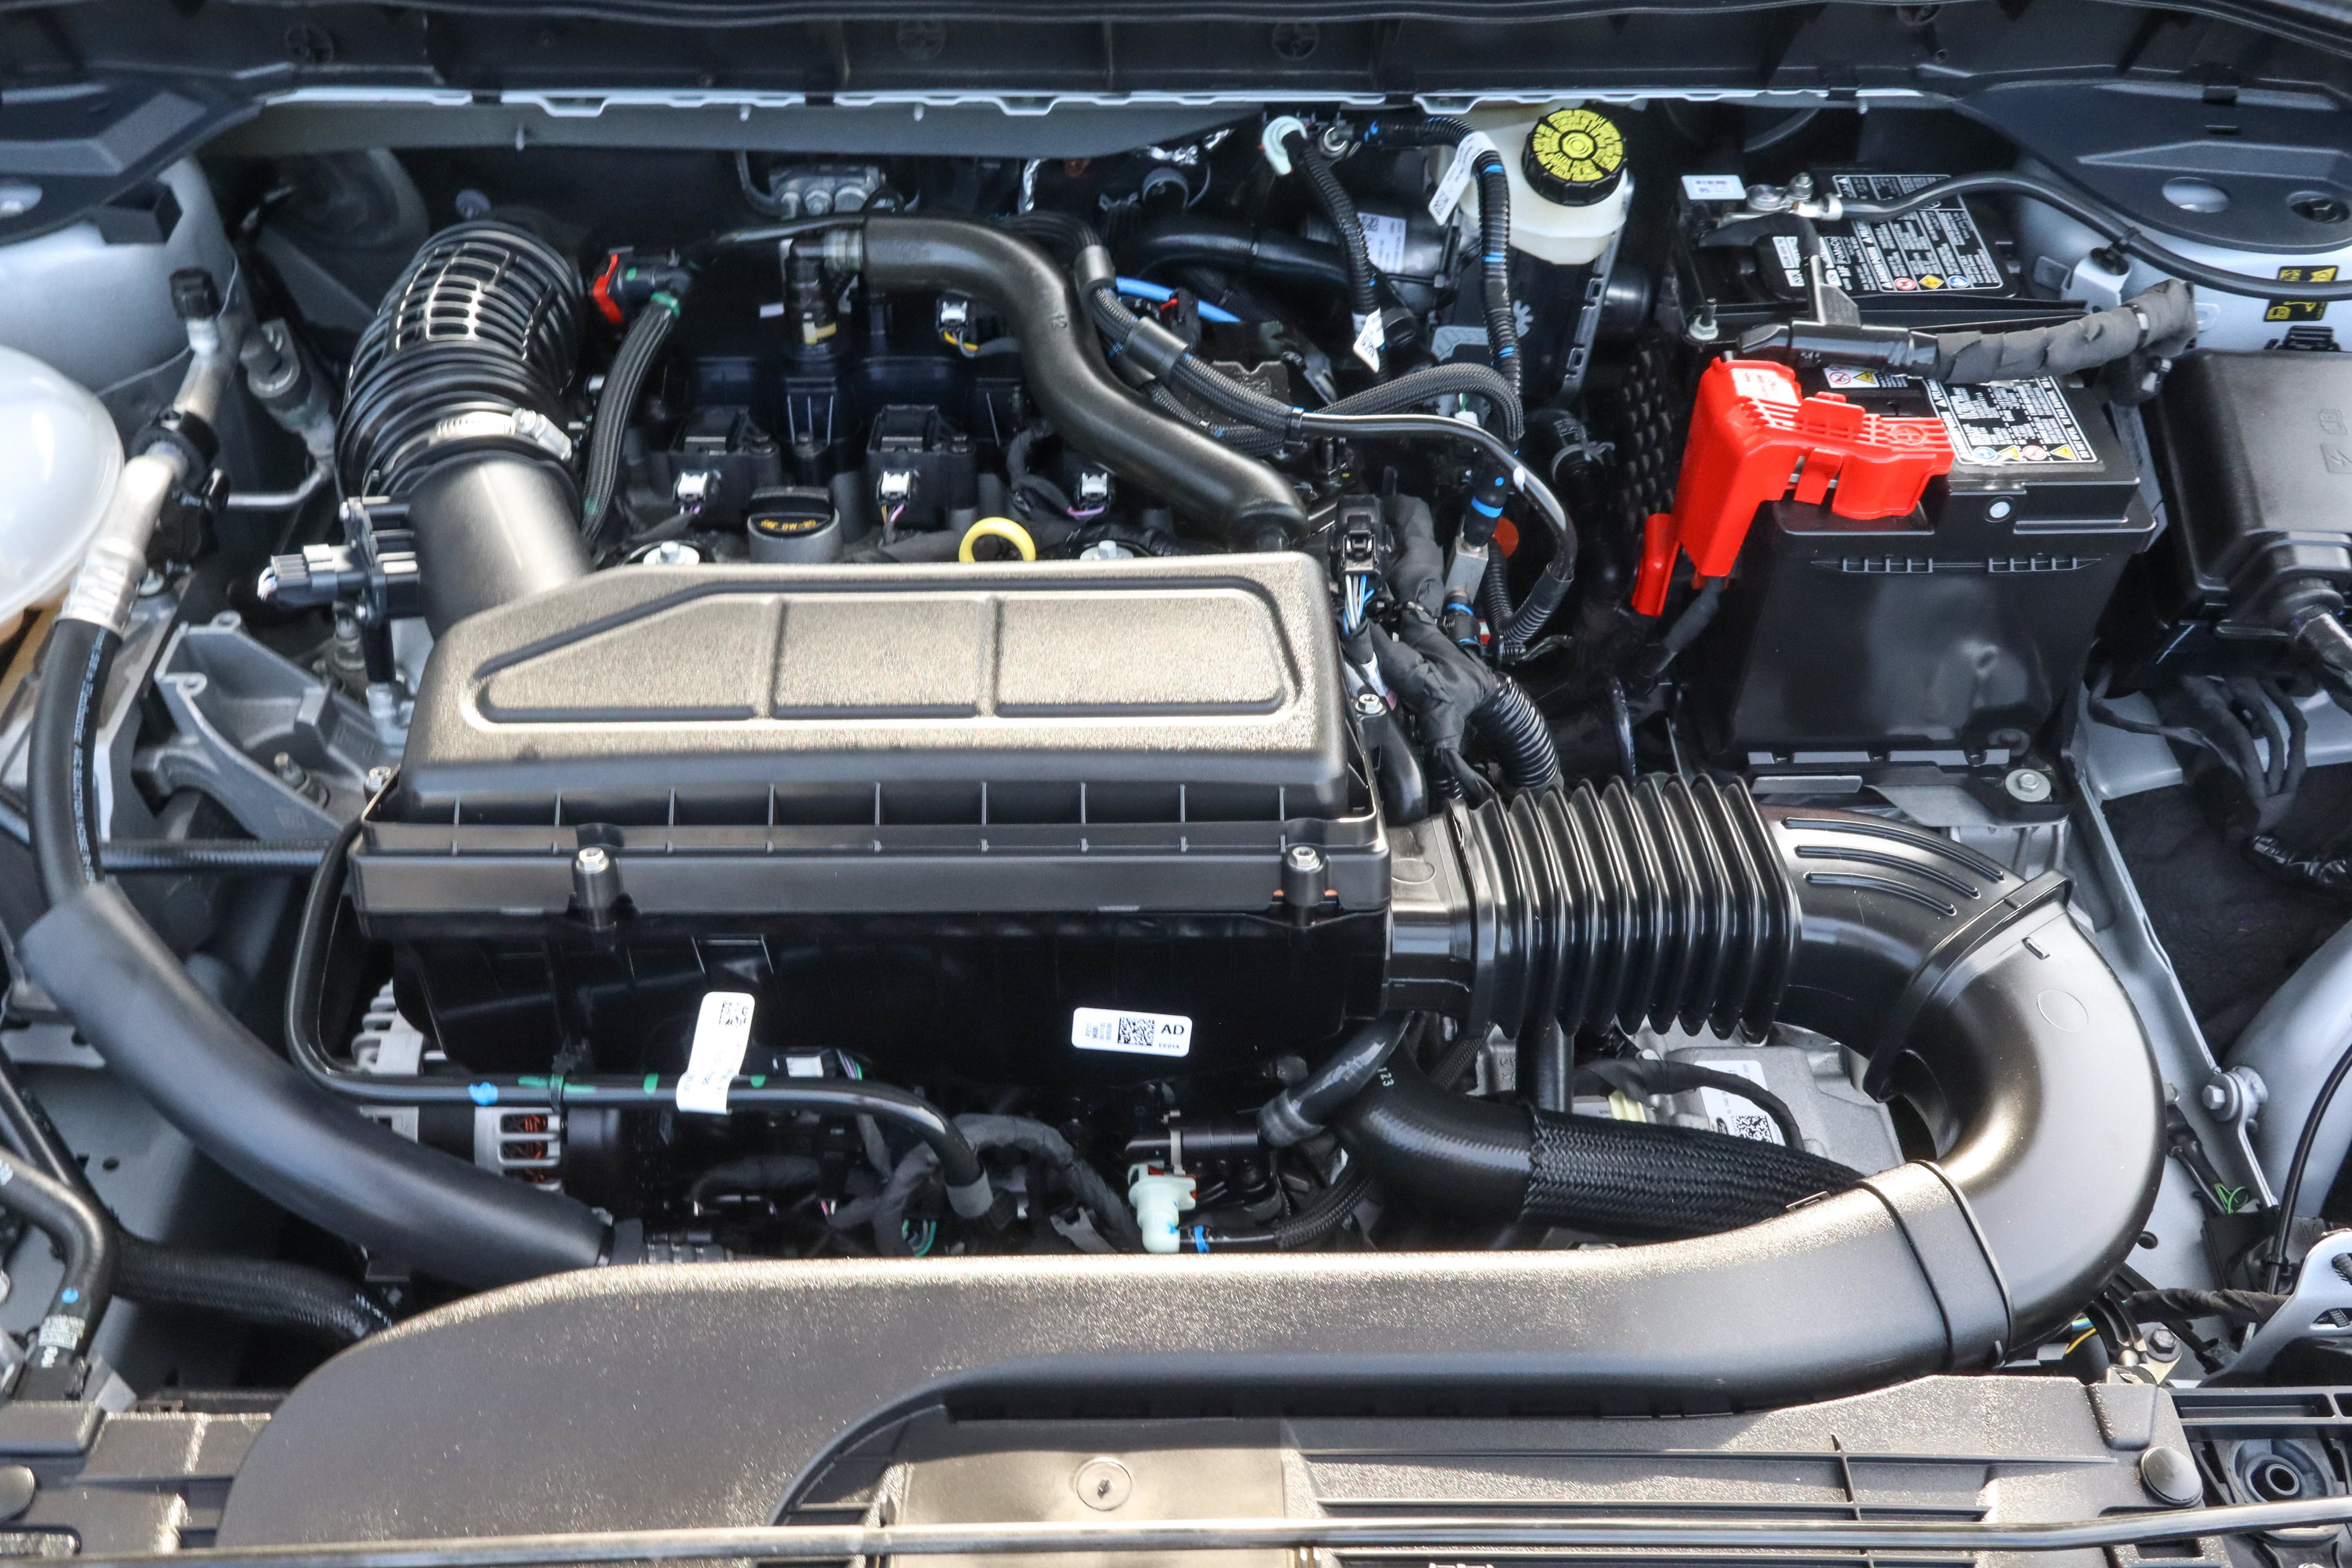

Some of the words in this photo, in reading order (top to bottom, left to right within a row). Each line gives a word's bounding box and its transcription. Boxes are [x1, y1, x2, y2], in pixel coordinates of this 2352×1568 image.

[1830, 237, 1846, 263] FoMoCo
[2056, 409, 2069, 417] PAS
[2065, 426, 2082, 440] OPEN.
[2073, 441, 2087, 450] NOT
[1161, 1024, 1185, 1035] AD
